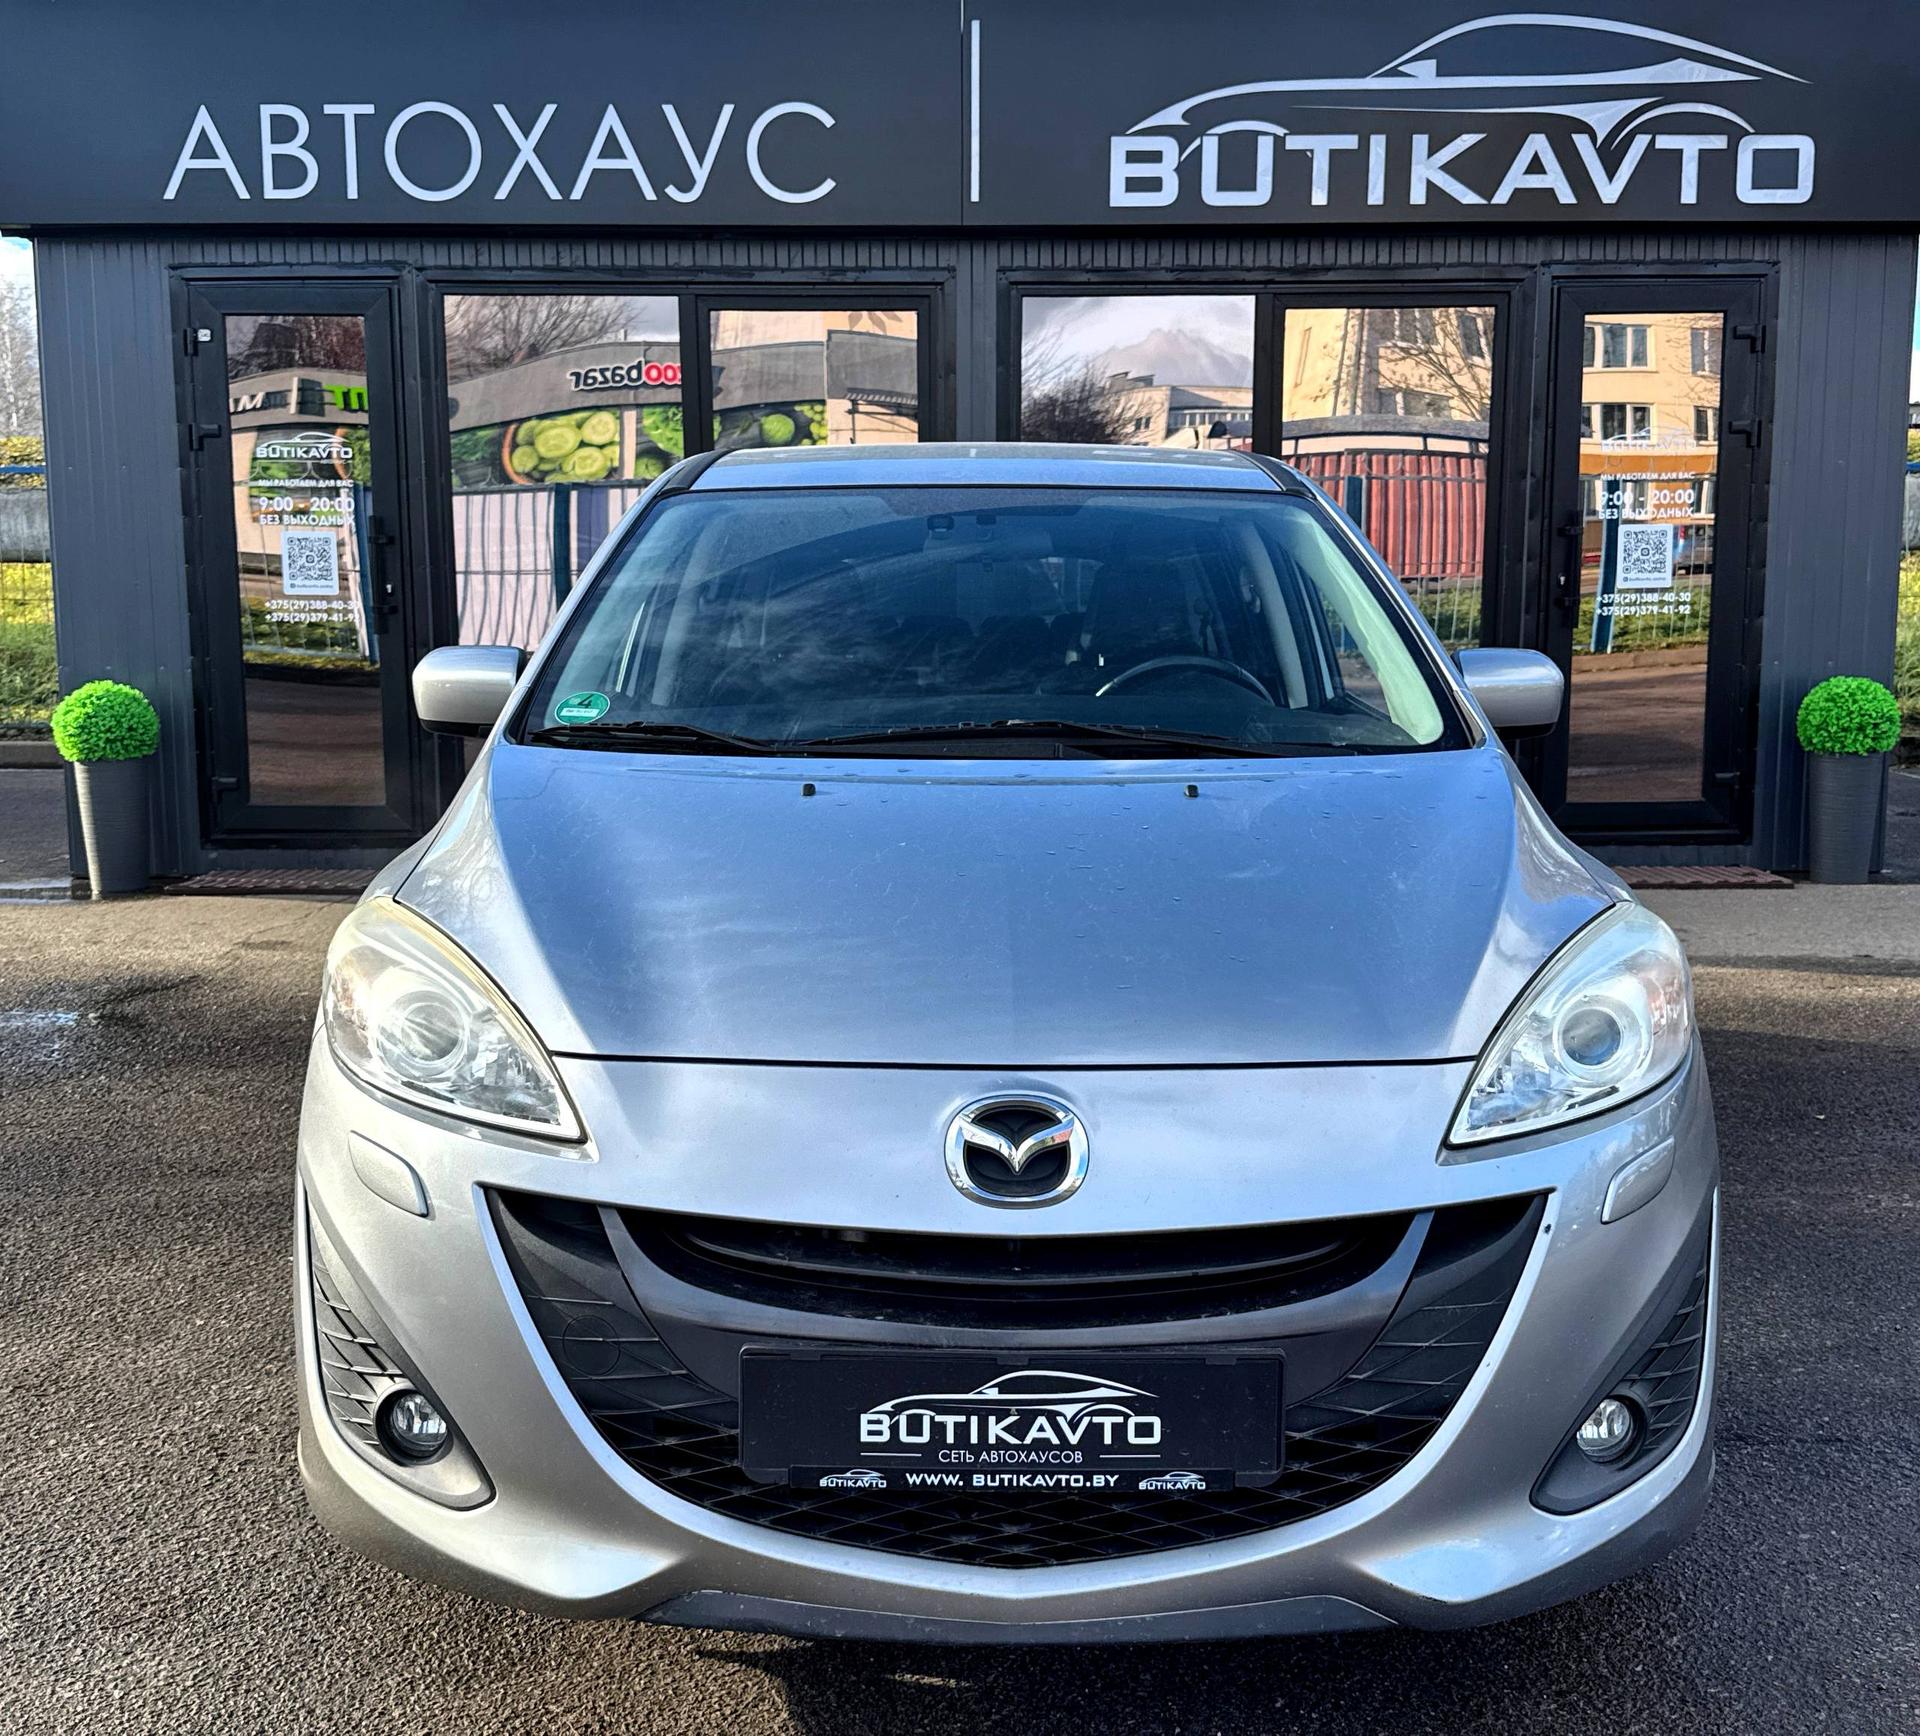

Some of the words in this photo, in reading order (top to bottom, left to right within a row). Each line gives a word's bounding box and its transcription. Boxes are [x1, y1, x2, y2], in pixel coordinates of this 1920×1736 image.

[163, 100, 837, 204] АВТОХАУС
[1108, 133, 1816, 207] BUTIKAVTO
[256, 446, 353, 459] BUTIKAVTO
[1679, 471, 1696, 479] ВАС
[336, 479, 355, 488] ВАС
[259, 496, 294, 512] 9:00
[310, 496, 355, 512] 20:00
[1600, 490, 1634, 506] 9:00
[1652, 488, 1695, 505] 20:00
[259, 514, 280, 525] БЕЗ
[283, 514, 355, 527] ВЫХОДНЫХ
[1598, 508, 1619, 520] БЕЗ
[577, 693, 594, 709] 4
[860, 1412, 1162, 1445] BUTIKAVTO
[938, 1449, 975, 1463] СЕТЬ
[979, 1450, 1083, 1464] АВТОХАУСОВ
[819, 1477, 887, 1489] BUTIKAVTO
[905, 1472, 964, 1487] WWW.
[972, 1473, 1120, 1488] BUTIKAVTO.BY
[1138, 1479, 1206, 1491] BUTIKAVTO
